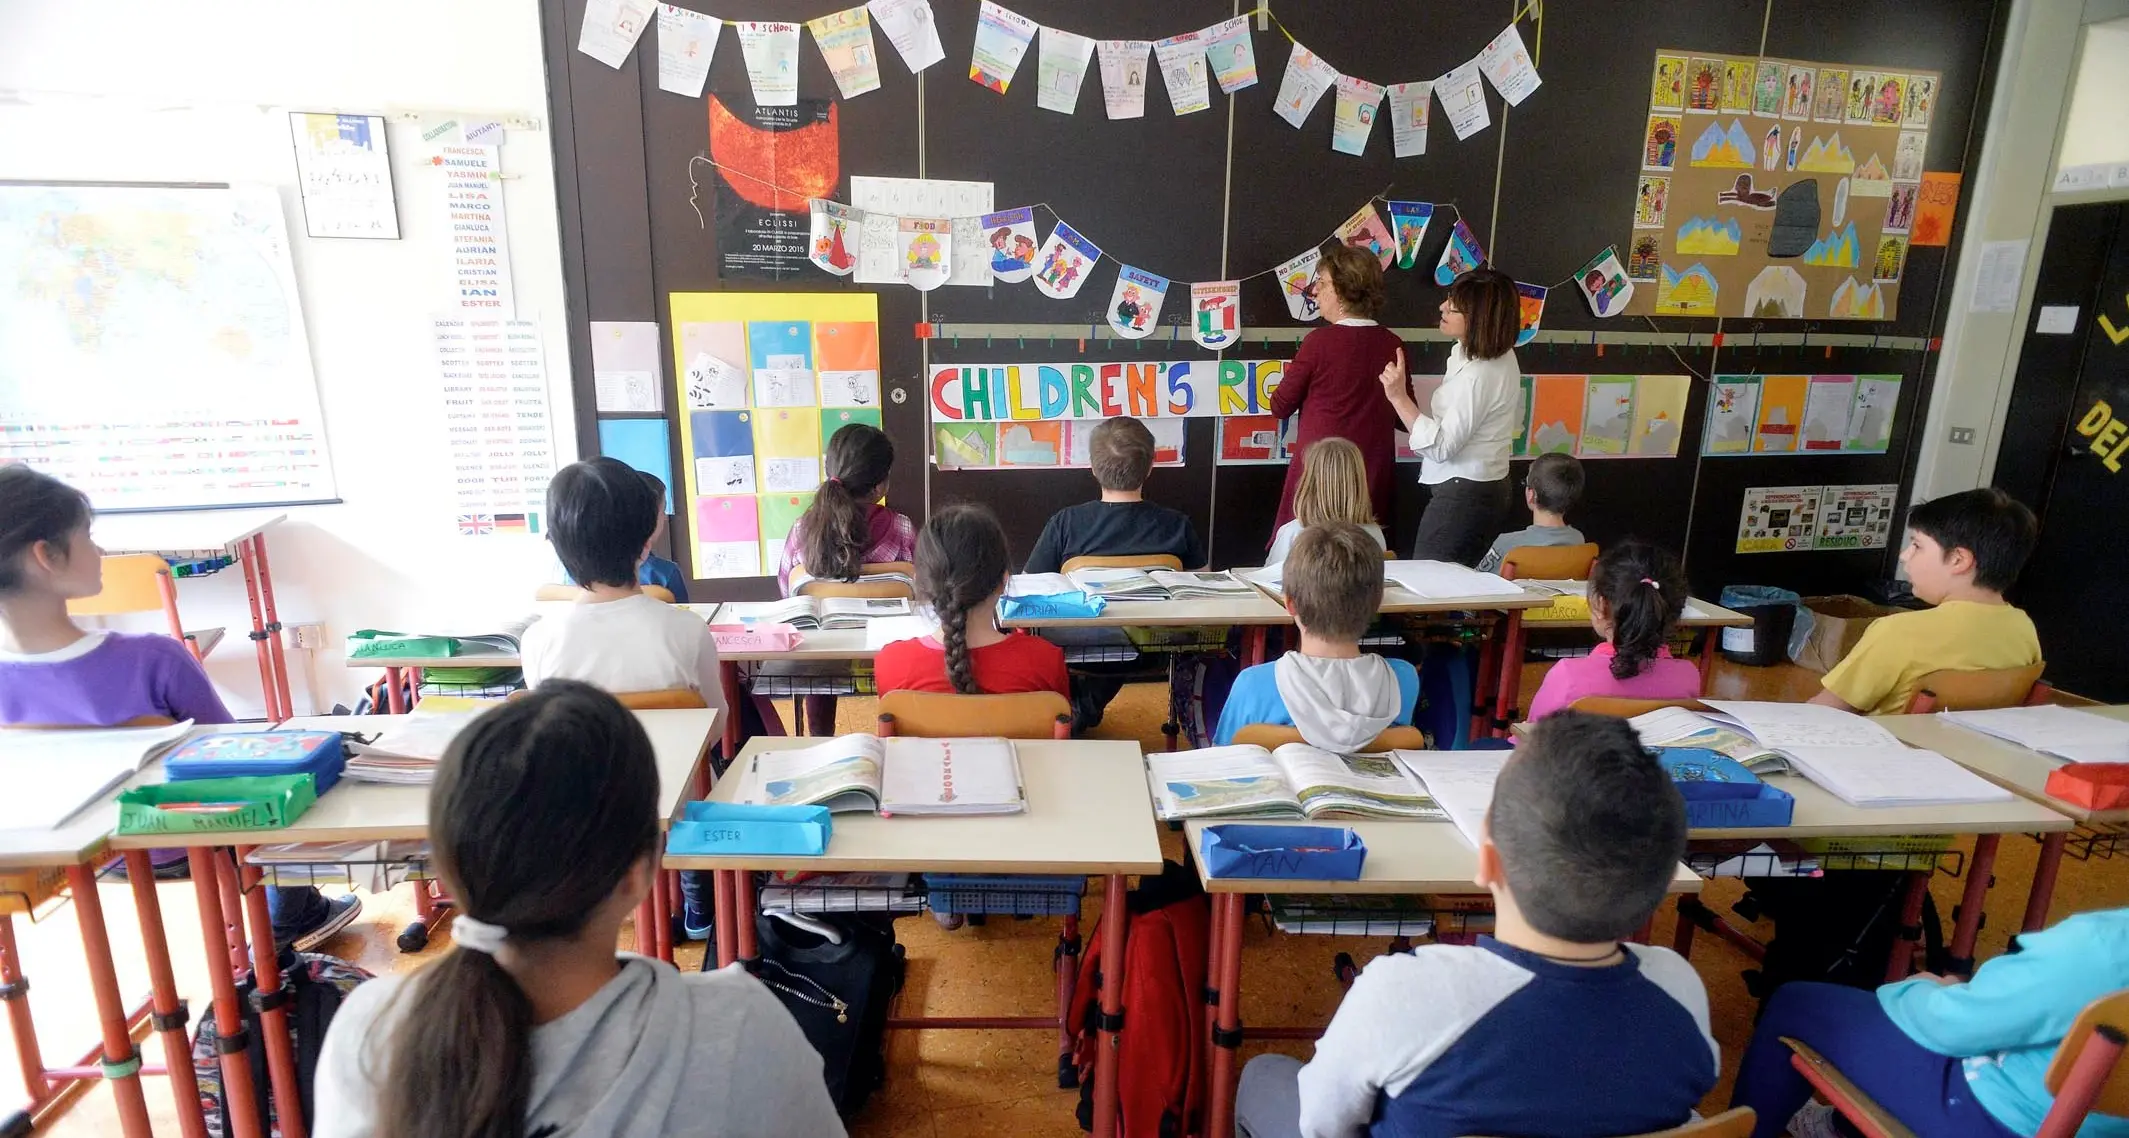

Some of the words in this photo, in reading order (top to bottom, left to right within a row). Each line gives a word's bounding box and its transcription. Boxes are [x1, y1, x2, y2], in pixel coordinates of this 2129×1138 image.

[762, 23, 795, 33] SCHOOL
[755, 107, 799, 118] ATLANTIS
[443, 147, 485, 156] FRANCESCA
[444, 159, 488, 168] SAMUELE
[446, 171, 488, 179] YASMIN
[448, 192, 489, 200] LISA
[449, 202, 491, 210] MARCO
[450, 212, 491, 221] MARTINA
[454, 224, 490, 232] GIANLUCA
[758, 219, 797, 228] ECLISSI
[913, 220, 936, 230] FOOD
[454, 235, 495, 243] STEFANIA
[455, 246, 497, 254] ADRIAN
[752, 243, 762, 252] 20
[762, 244, 788, 253] MARZO
[788, 245, 805, 253] 2015
[456, 258, 497, 266] ILARIA
[1278, 266, 1288, 276] NO
[1289, 251, 1319, 270] SLAVERY
[1128, 271, 1161, 288] SAFETY
[461, 288, 498, 297] IAN
[461, 300, 502, 308] ESTER
[931, 362, 1195, 421] CHILDREN'S
[1218, 359, 1292, 415] RIG
[2075, 399, 2129, 473] DEL
[716, 634, 762, 646] ANCESCA
[1687, 801, 1752, 823] ARTINA
[120, 811, 168, 831] JUAN
[703, 829, 742, 842] ESTER
